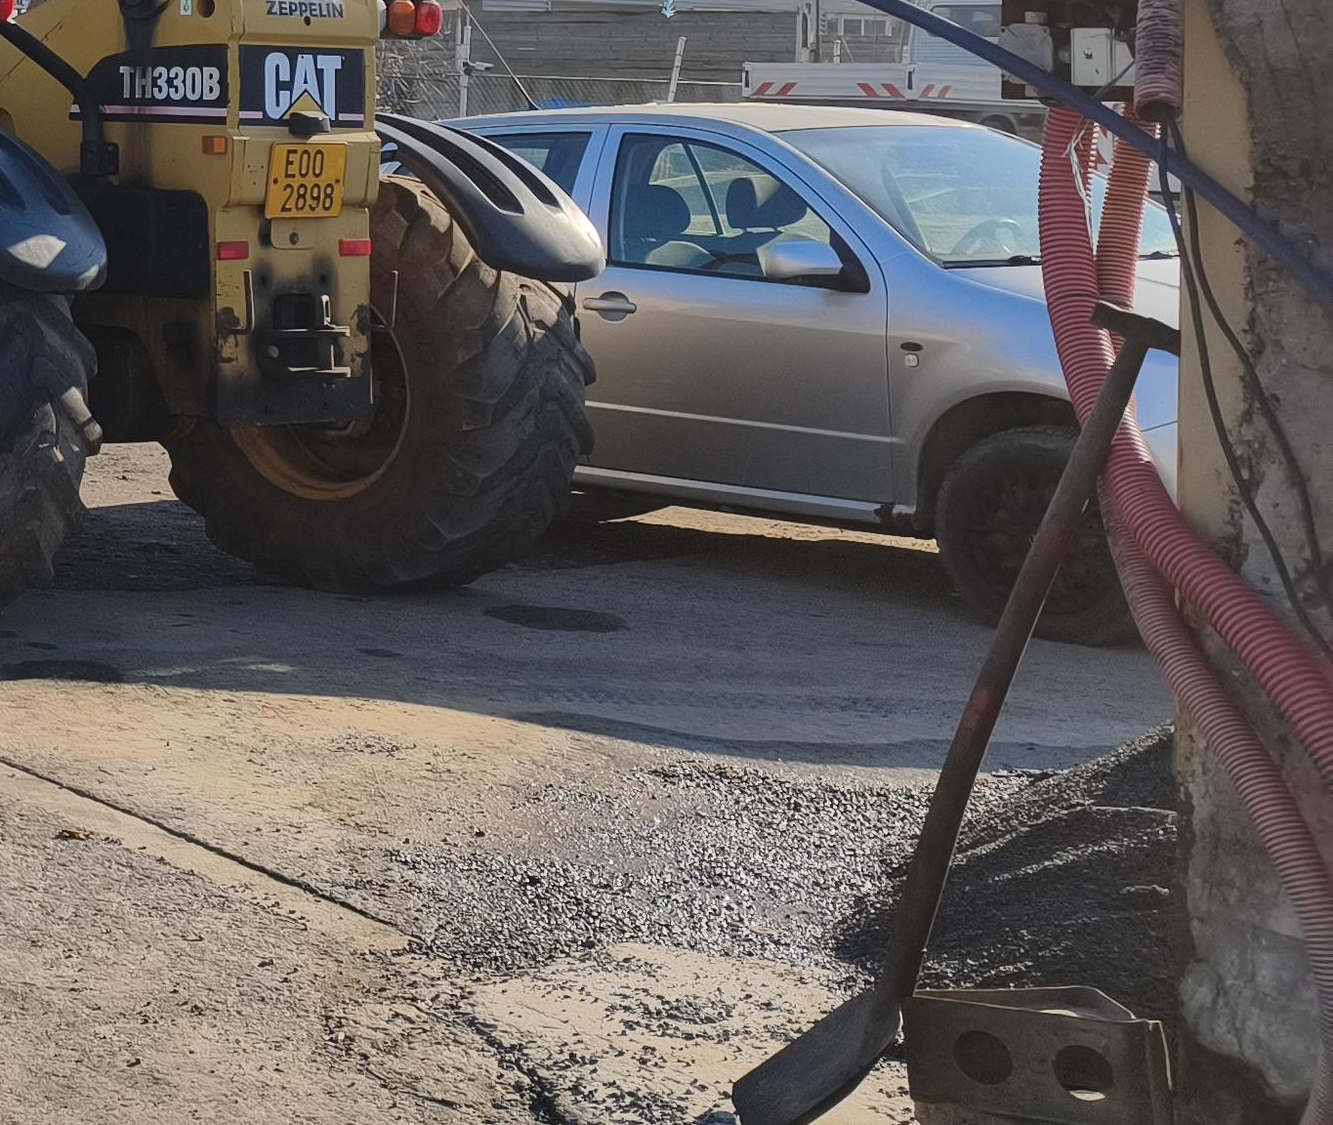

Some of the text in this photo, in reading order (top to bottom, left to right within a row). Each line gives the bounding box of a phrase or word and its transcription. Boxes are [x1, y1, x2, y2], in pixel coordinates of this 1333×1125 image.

[266, 1, 344, 19] ZEPPELIN
[119, 66, 220, 101] TH330B
[264, 52, 342, 121] CAT
[281, 183, 335, 212] 2898
